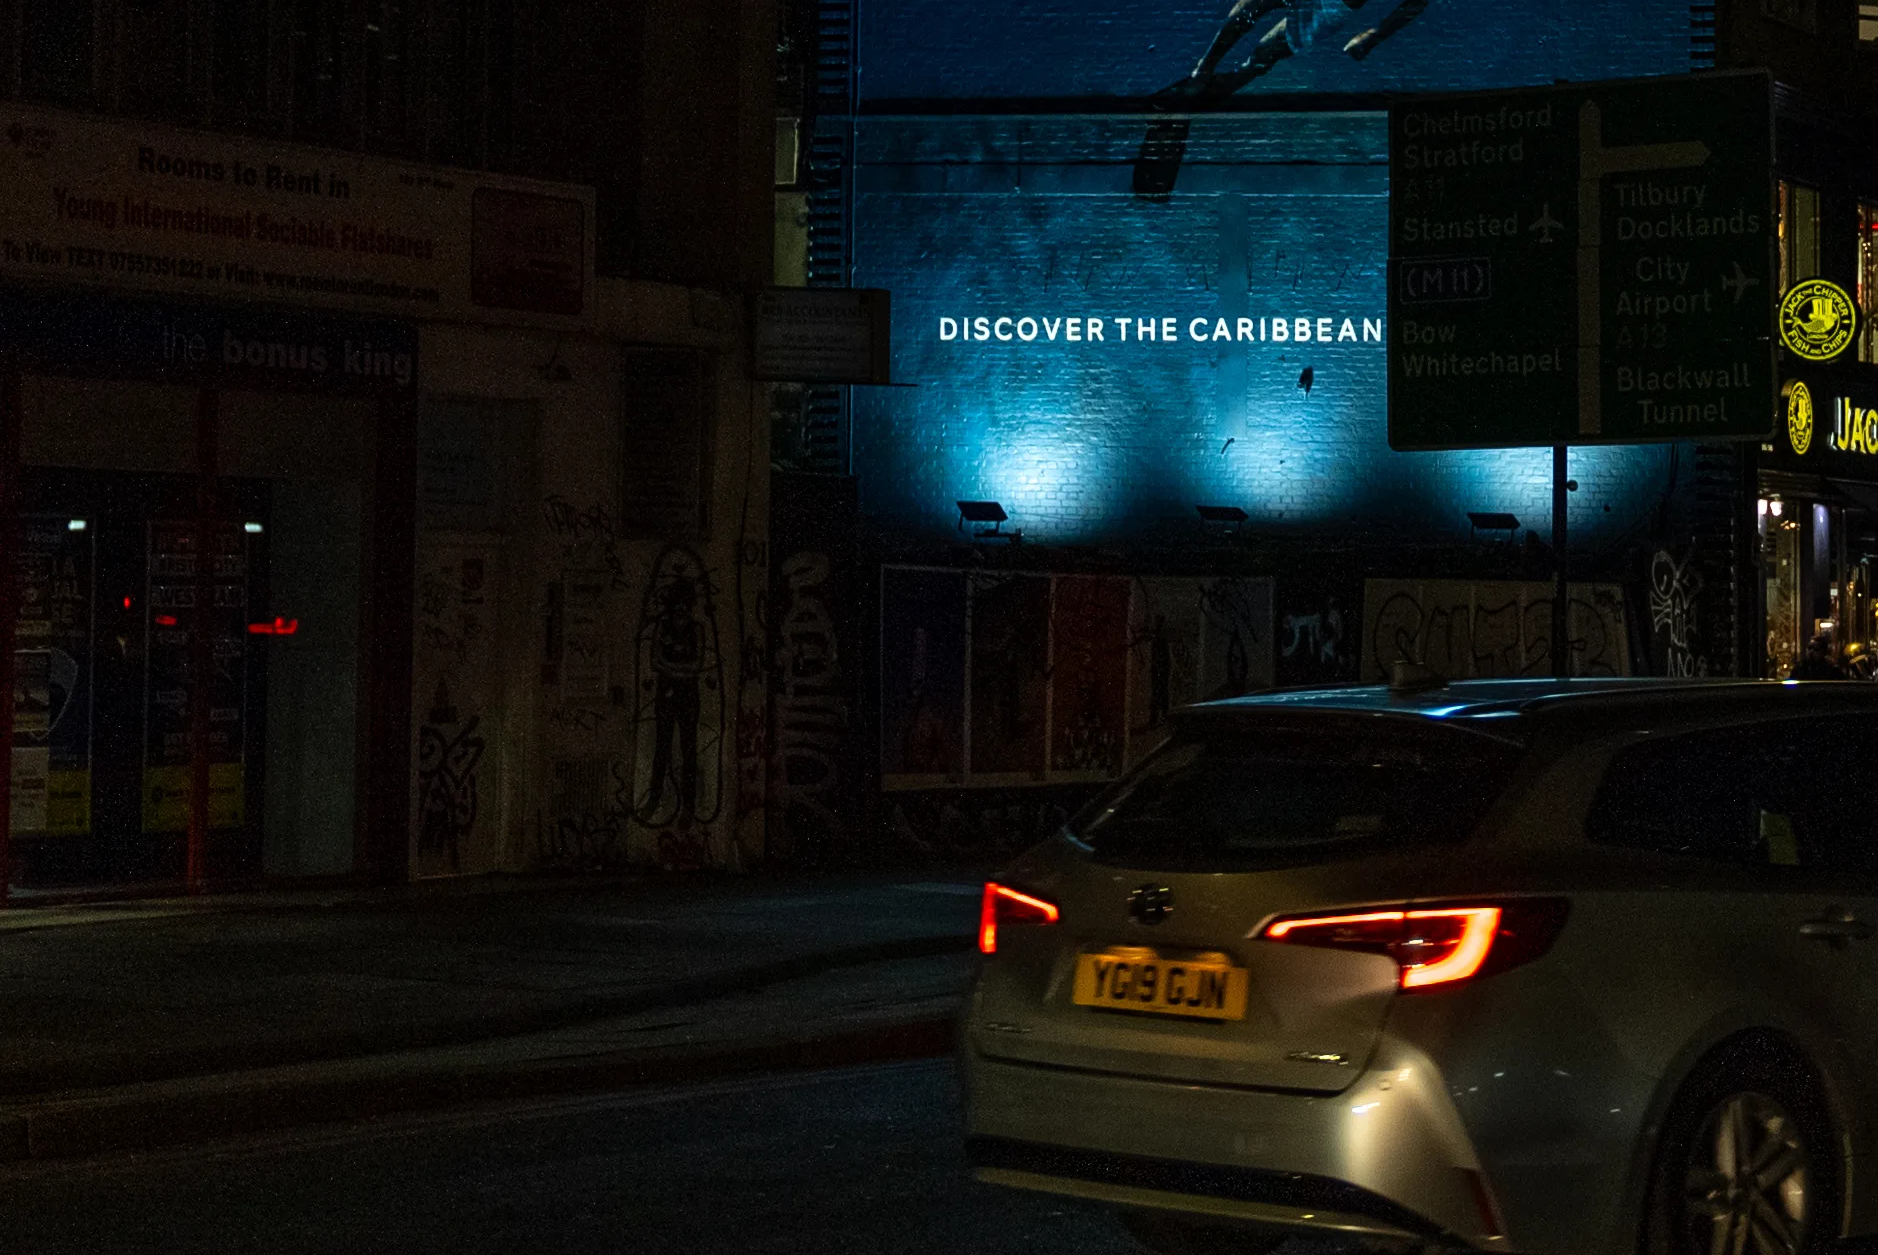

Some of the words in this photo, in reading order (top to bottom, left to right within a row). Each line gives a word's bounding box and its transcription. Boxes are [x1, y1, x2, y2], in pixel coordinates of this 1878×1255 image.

[1403, 104, 1552, 137] Chelmsford
[1404, 137, 1524, 169] Stratford
[138, 148, 223, 181] Rooms
[234, 163, 257, 187] to
[267, 166, 321, 195] Rent
[329, 173, 350, 198] in
[1614, 182, 1707, 209] Tilbury
[54, 189, 116, 229] Young
[125, 197, 251, 241] International
[256, 214, 334, 249] Sociable
[1404, 210, 1519, 242] Stansted
[1617, 208, 1760, 241] Docklands
[1636, 256, 1690, 286] City
[1616, 287, 1712, 320] Airport
[1785, 292, 1804, 316] JACK
[1813, 285, 1849, 316] CHIPPER
[939, 317, 1104, 341] DISCOVER
[1114, 317, 1178, 341] THE
[1189, 317, 1382, 342] CARIBBEAN
[1402, 321, 1457, 345] Bow
[1788, 330, 1810, 352] FISH
[1821, 330, 1847, 353] CHIPS
[222, 329, 328, 373] bonus
[344, 340, 411, 386] king
[1402, 348, 1562, 377] Whitechapel
[1617, 363, 1751, 392] Blackwall
[1637, 397, 1728, 425] Tunnel
[1094, 961, 1156, 1002] YG19
